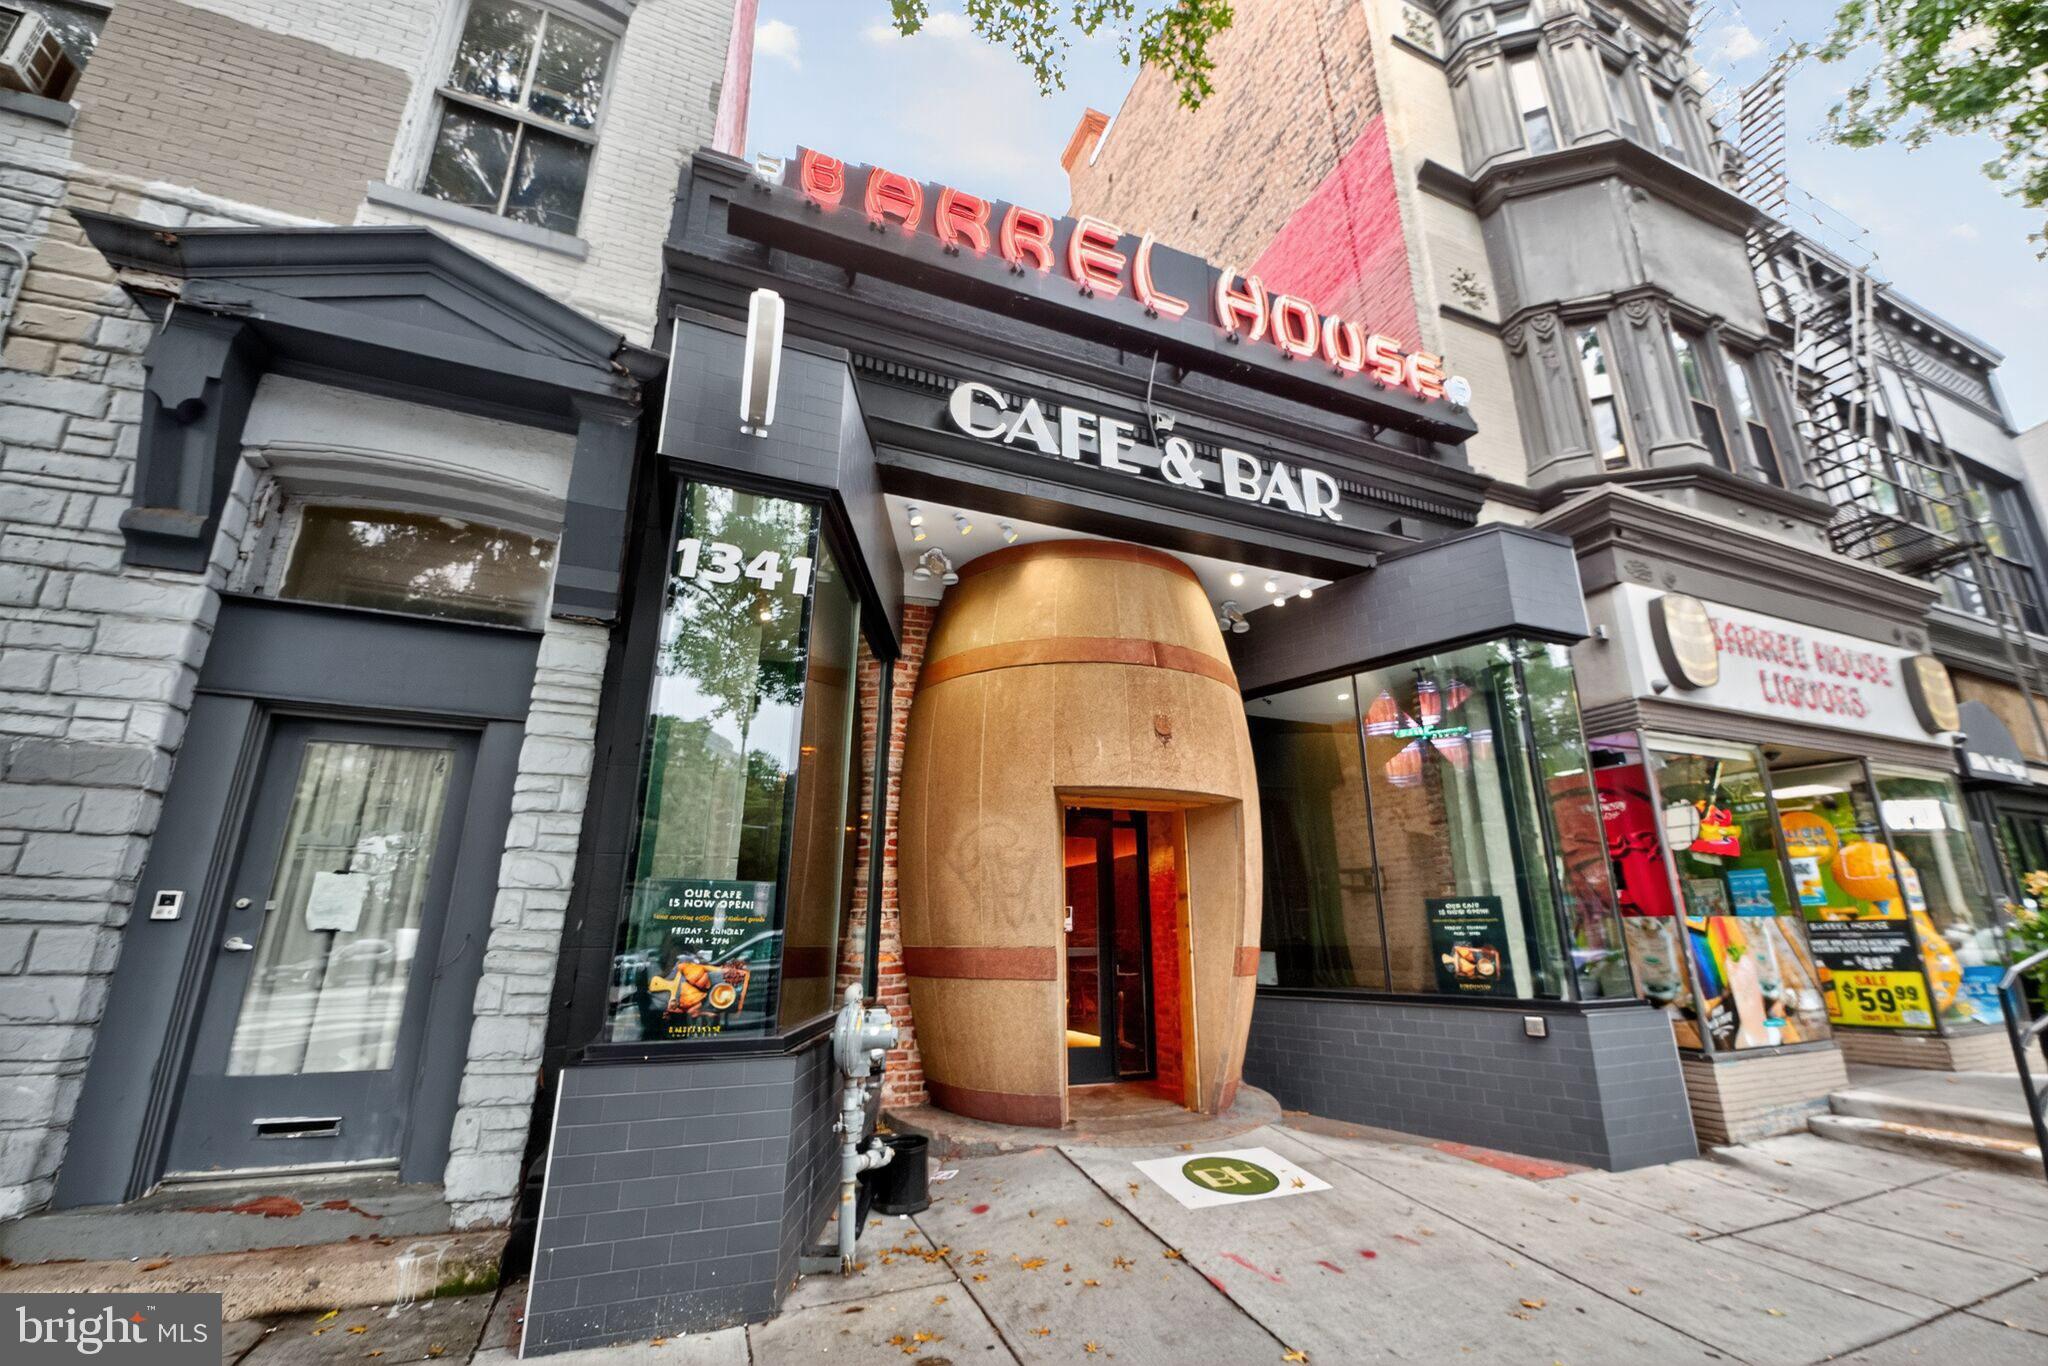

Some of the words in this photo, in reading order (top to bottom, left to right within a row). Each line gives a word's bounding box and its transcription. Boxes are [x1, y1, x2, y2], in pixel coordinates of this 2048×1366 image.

[801, 147, 1190, 317] BARREL
[1214, 266, 1447, 400] HOUSE
[949, 382, 1141, 475] CAFE
[1160, 436, 1205, 490] &
[1221, 447, 1343, 522] BAR
[675, 537, 813, 597] 1341
[1812, 640, 1894, 688] HOUSE
[1758, 669, 1868, 719] LIQUORS
[668, 898, 681, 908] IS
[683, 898, 716, 909] NOW
[684, 888, 711, 899] OUR
[713, 890, 742, 900] CAFE
